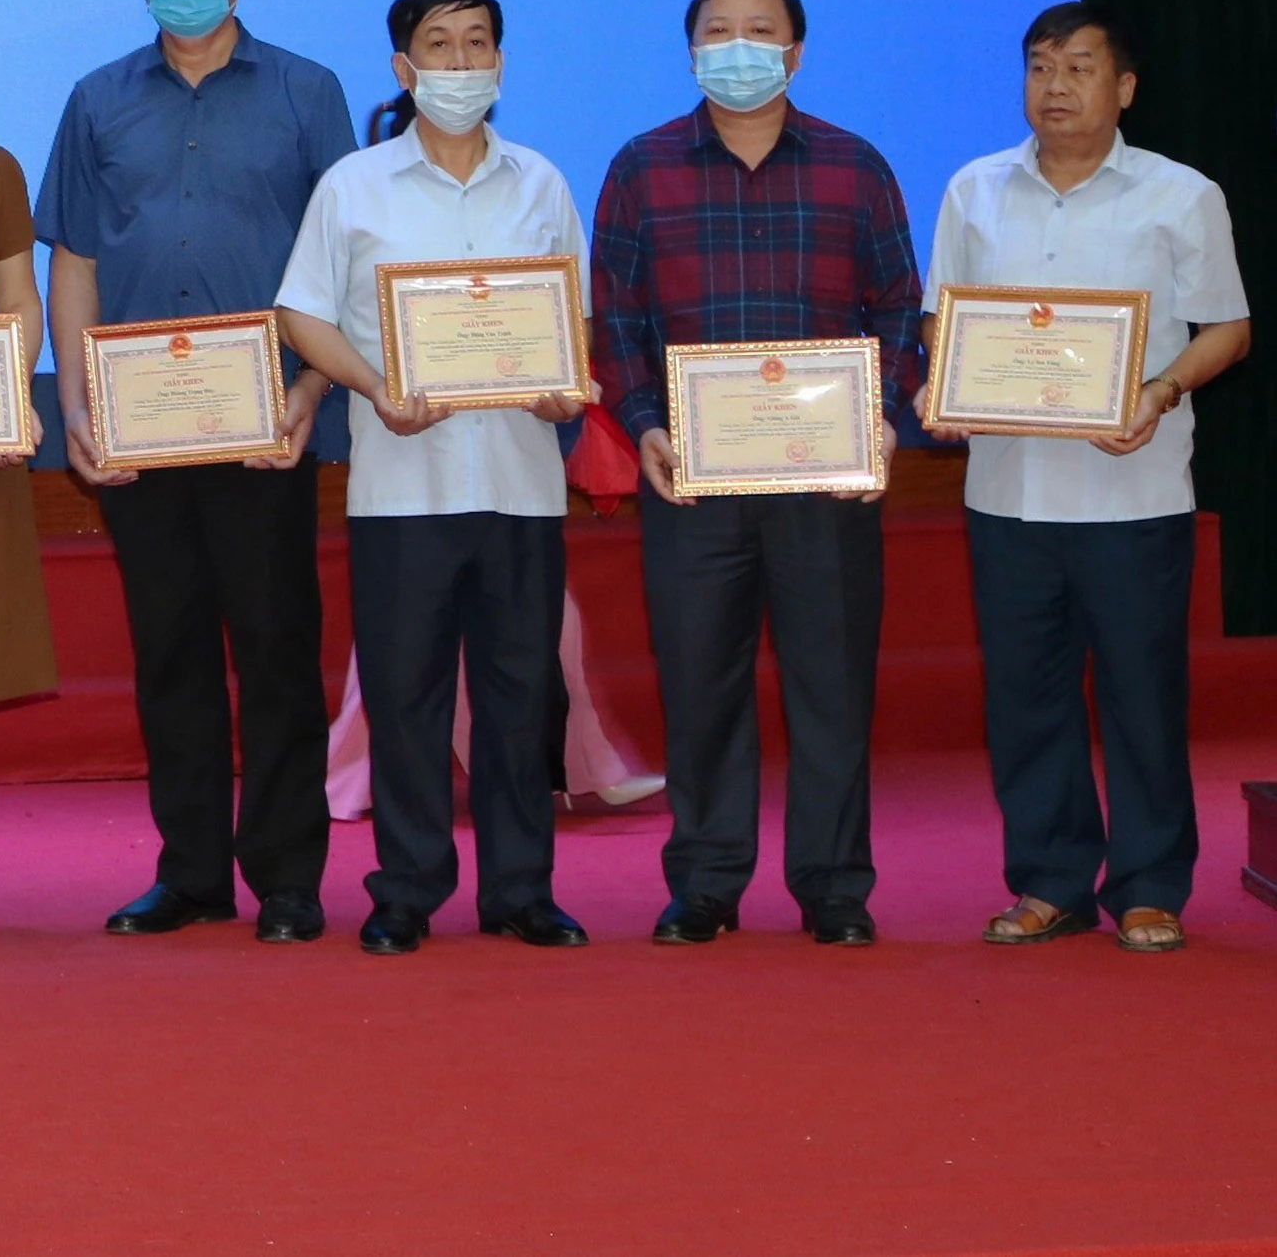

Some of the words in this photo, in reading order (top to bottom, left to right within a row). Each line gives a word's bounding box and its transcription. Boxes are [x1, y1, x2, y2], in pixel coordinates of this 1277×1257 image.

[462, 320, 481, 328] GIẤY
[1015, 347, 1035, 355] GIẤY
[164, 379, 181, 387] GIẤY
[753, 403, 772, 411] GIẤY
